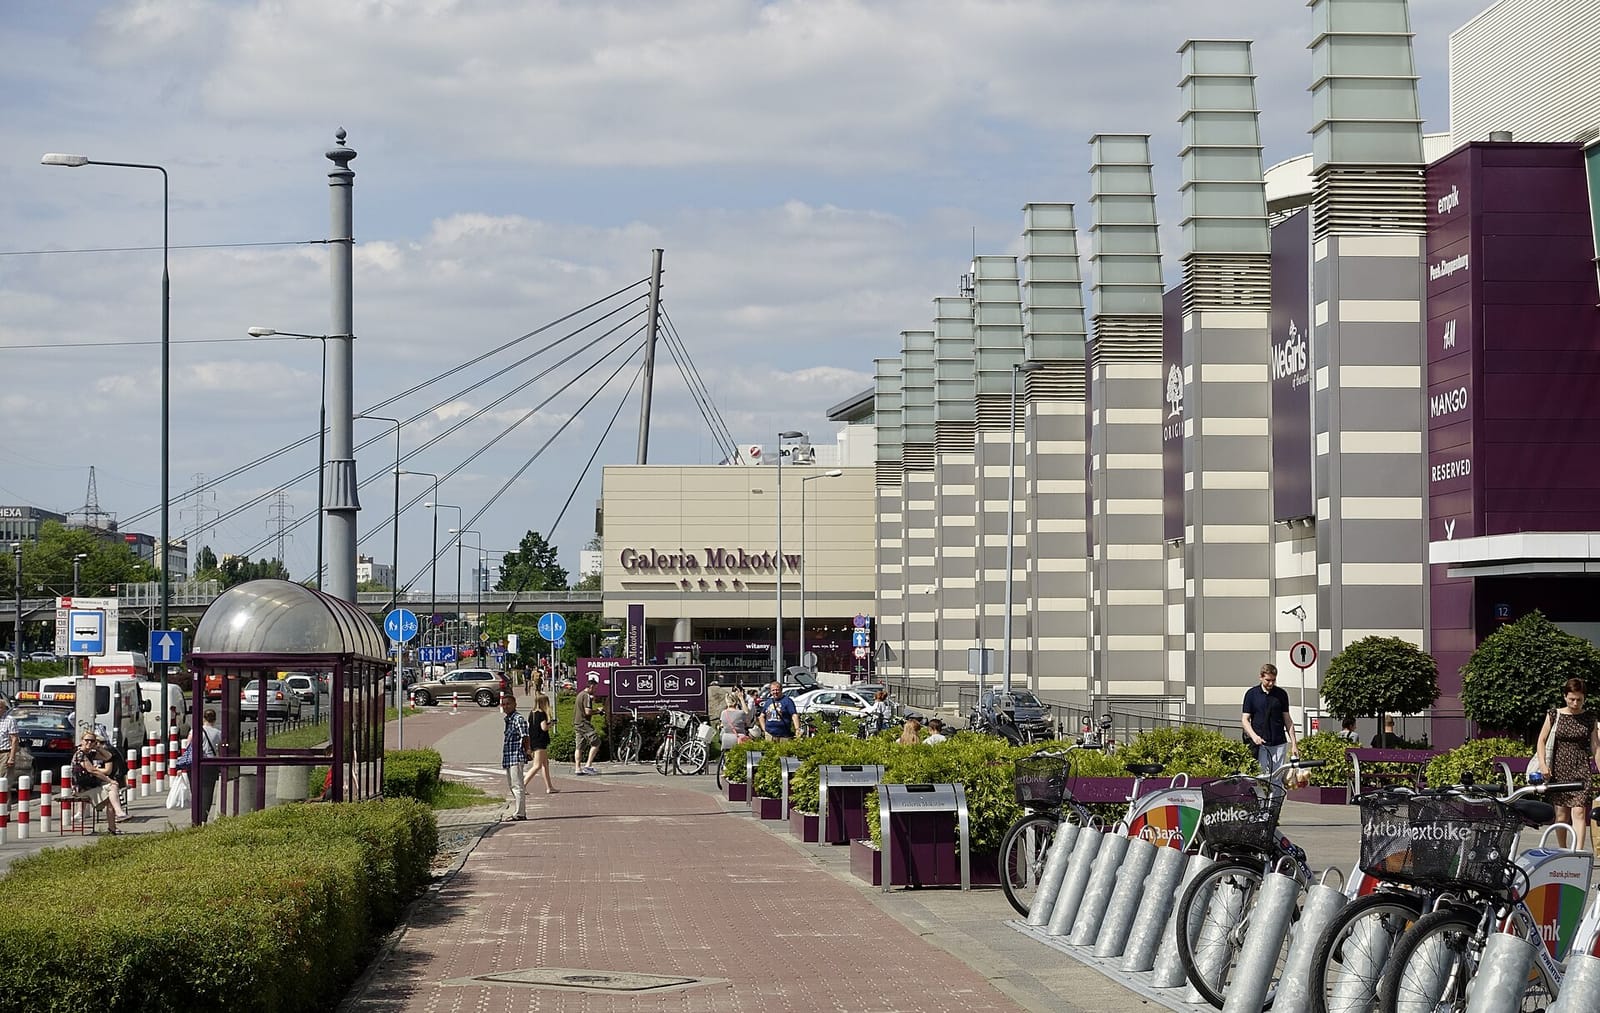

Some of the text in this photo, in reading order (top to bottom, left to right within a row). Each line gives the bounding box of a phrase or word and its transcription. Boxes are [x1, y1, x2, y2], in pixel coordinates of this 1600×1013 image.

[1438, 184, 1459, 214] empik
[1271, 334, 1306, 380] WeGirls
[1431, 387, 1467, 418] MANGO
[1432, 459, 1471, 482] RESERVED
[620, 548, 800, 569] Galeria Mokotów
[1498, 607, 1508, 617] 12
[745, 643, 770, 651] witamy
[1142, 826, 1184, 840] mBank
